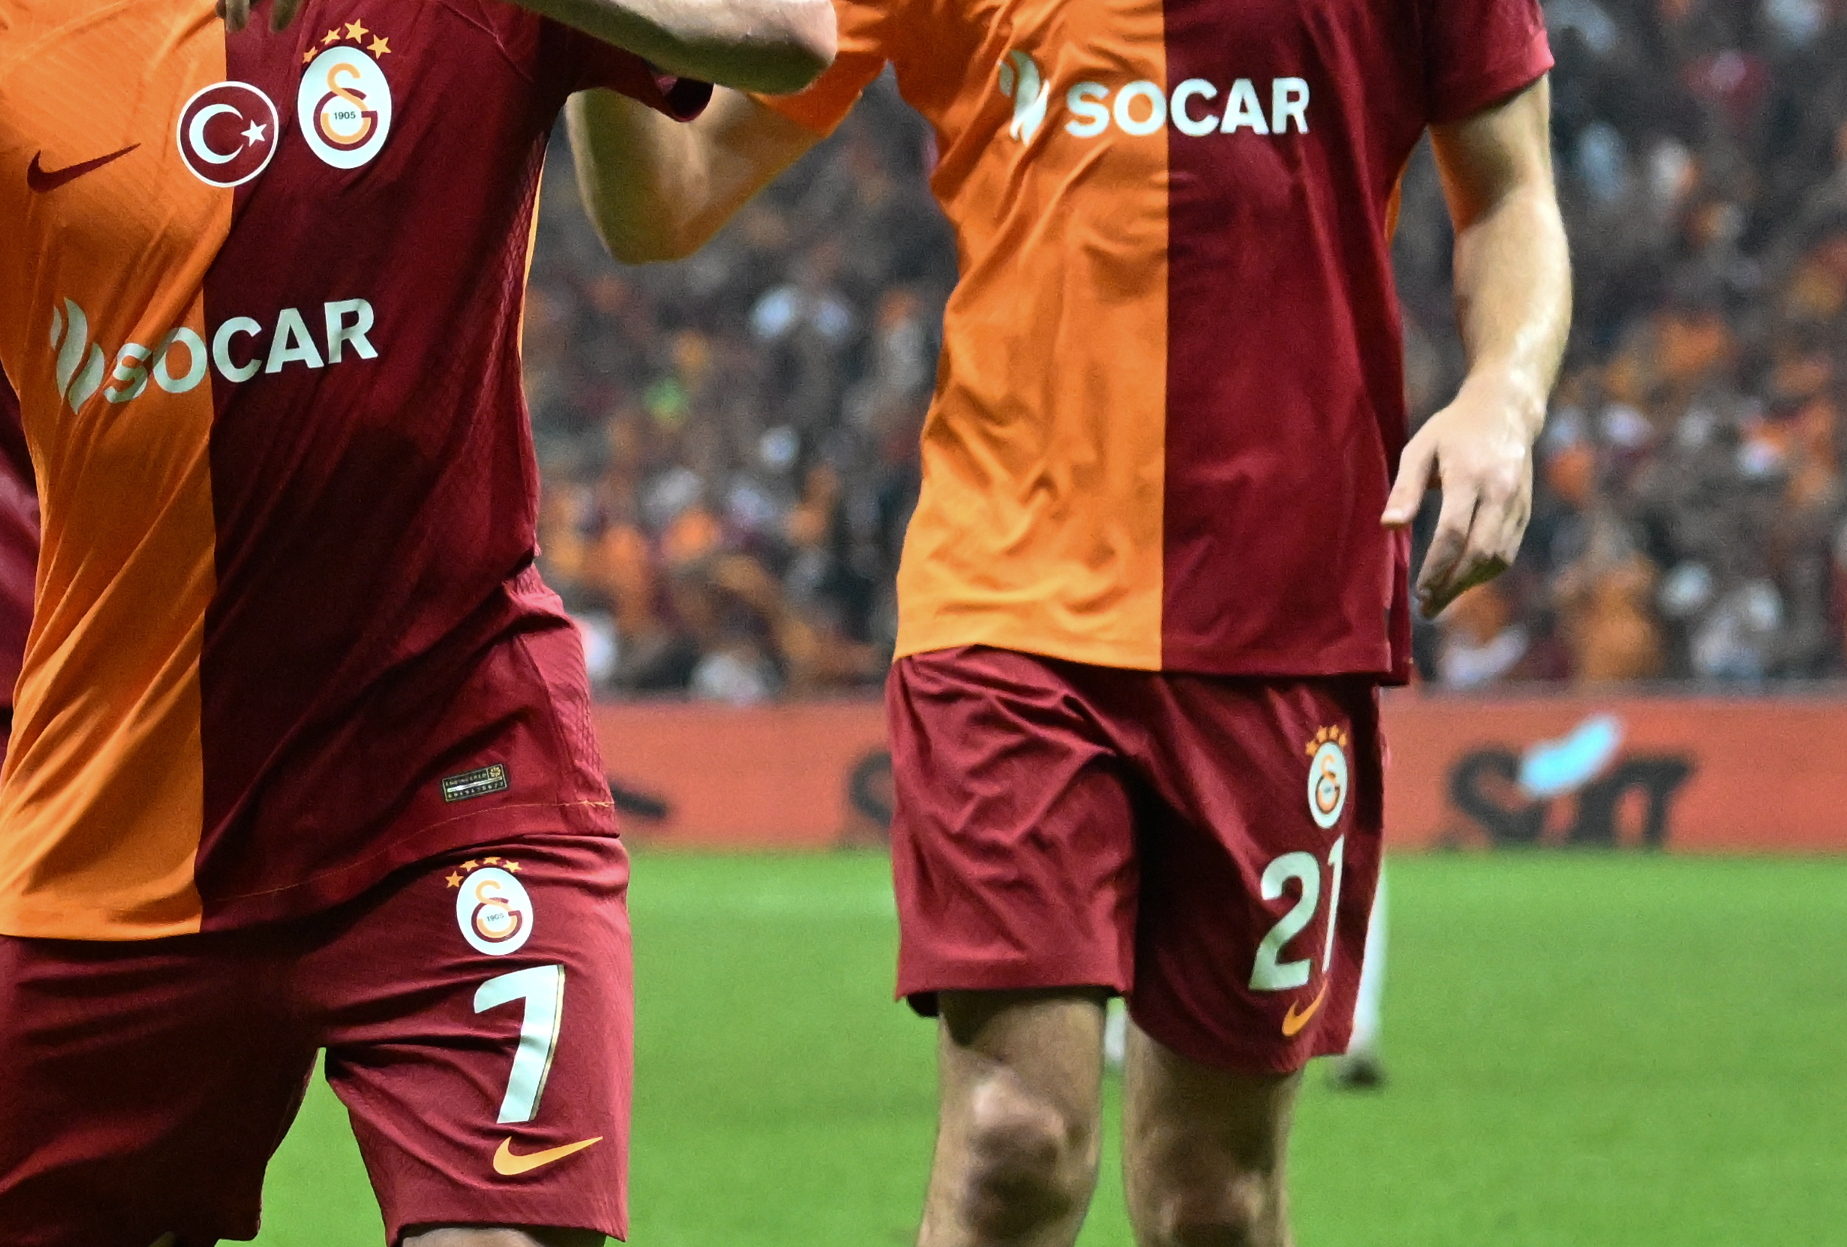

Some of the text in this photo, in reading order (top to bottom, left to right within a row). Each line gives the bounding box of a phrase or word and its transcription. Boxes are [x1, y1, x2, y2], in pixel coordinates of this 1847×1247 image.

[333, 110, 357, 120] 1905
[1065, 77, 1310, 138] SOCAR
[102, 298, 379, 405] SOCAR
[1248, 833, 1346, 992] 21
[472, 963, 566, 1124] 7
